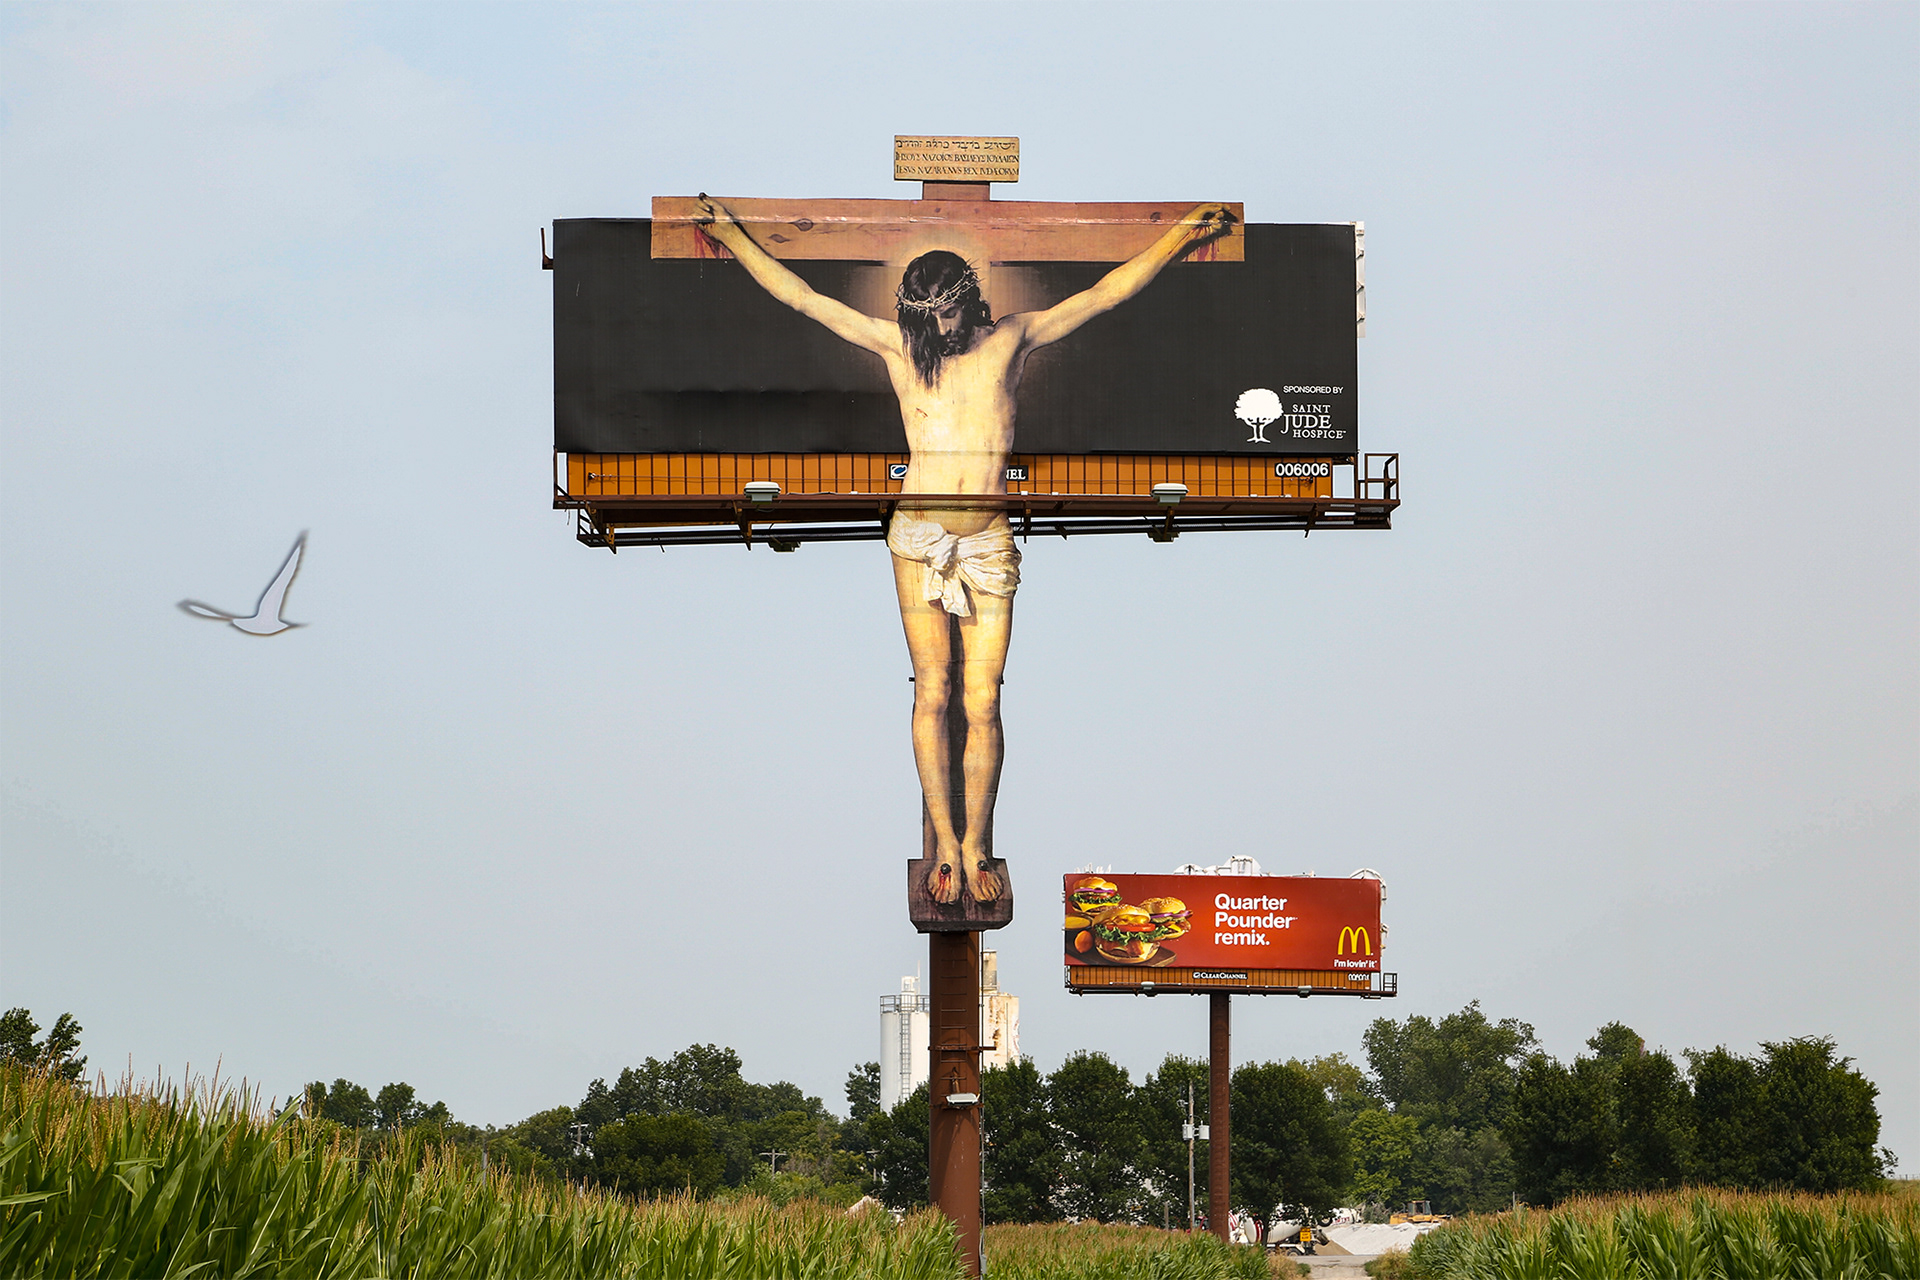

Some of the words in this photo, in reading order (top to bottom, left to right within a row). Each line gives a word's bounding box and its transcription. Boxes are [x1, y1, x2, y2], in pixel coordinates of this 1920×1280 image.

[1283, 385, 1331, 394] SPONSORED
[1332, 386, 1344, 394] BY
[1292, 404, 1331, 413] SAINT
[1280, 414, 1332, 434] JUDE
[1275, 463, 1329, 477] 006006
[1214, 893, 1288, 911] Quarter
[1214, 929, 1270, 946] remix.
[1346, 959, 1368, 968] lovin'
